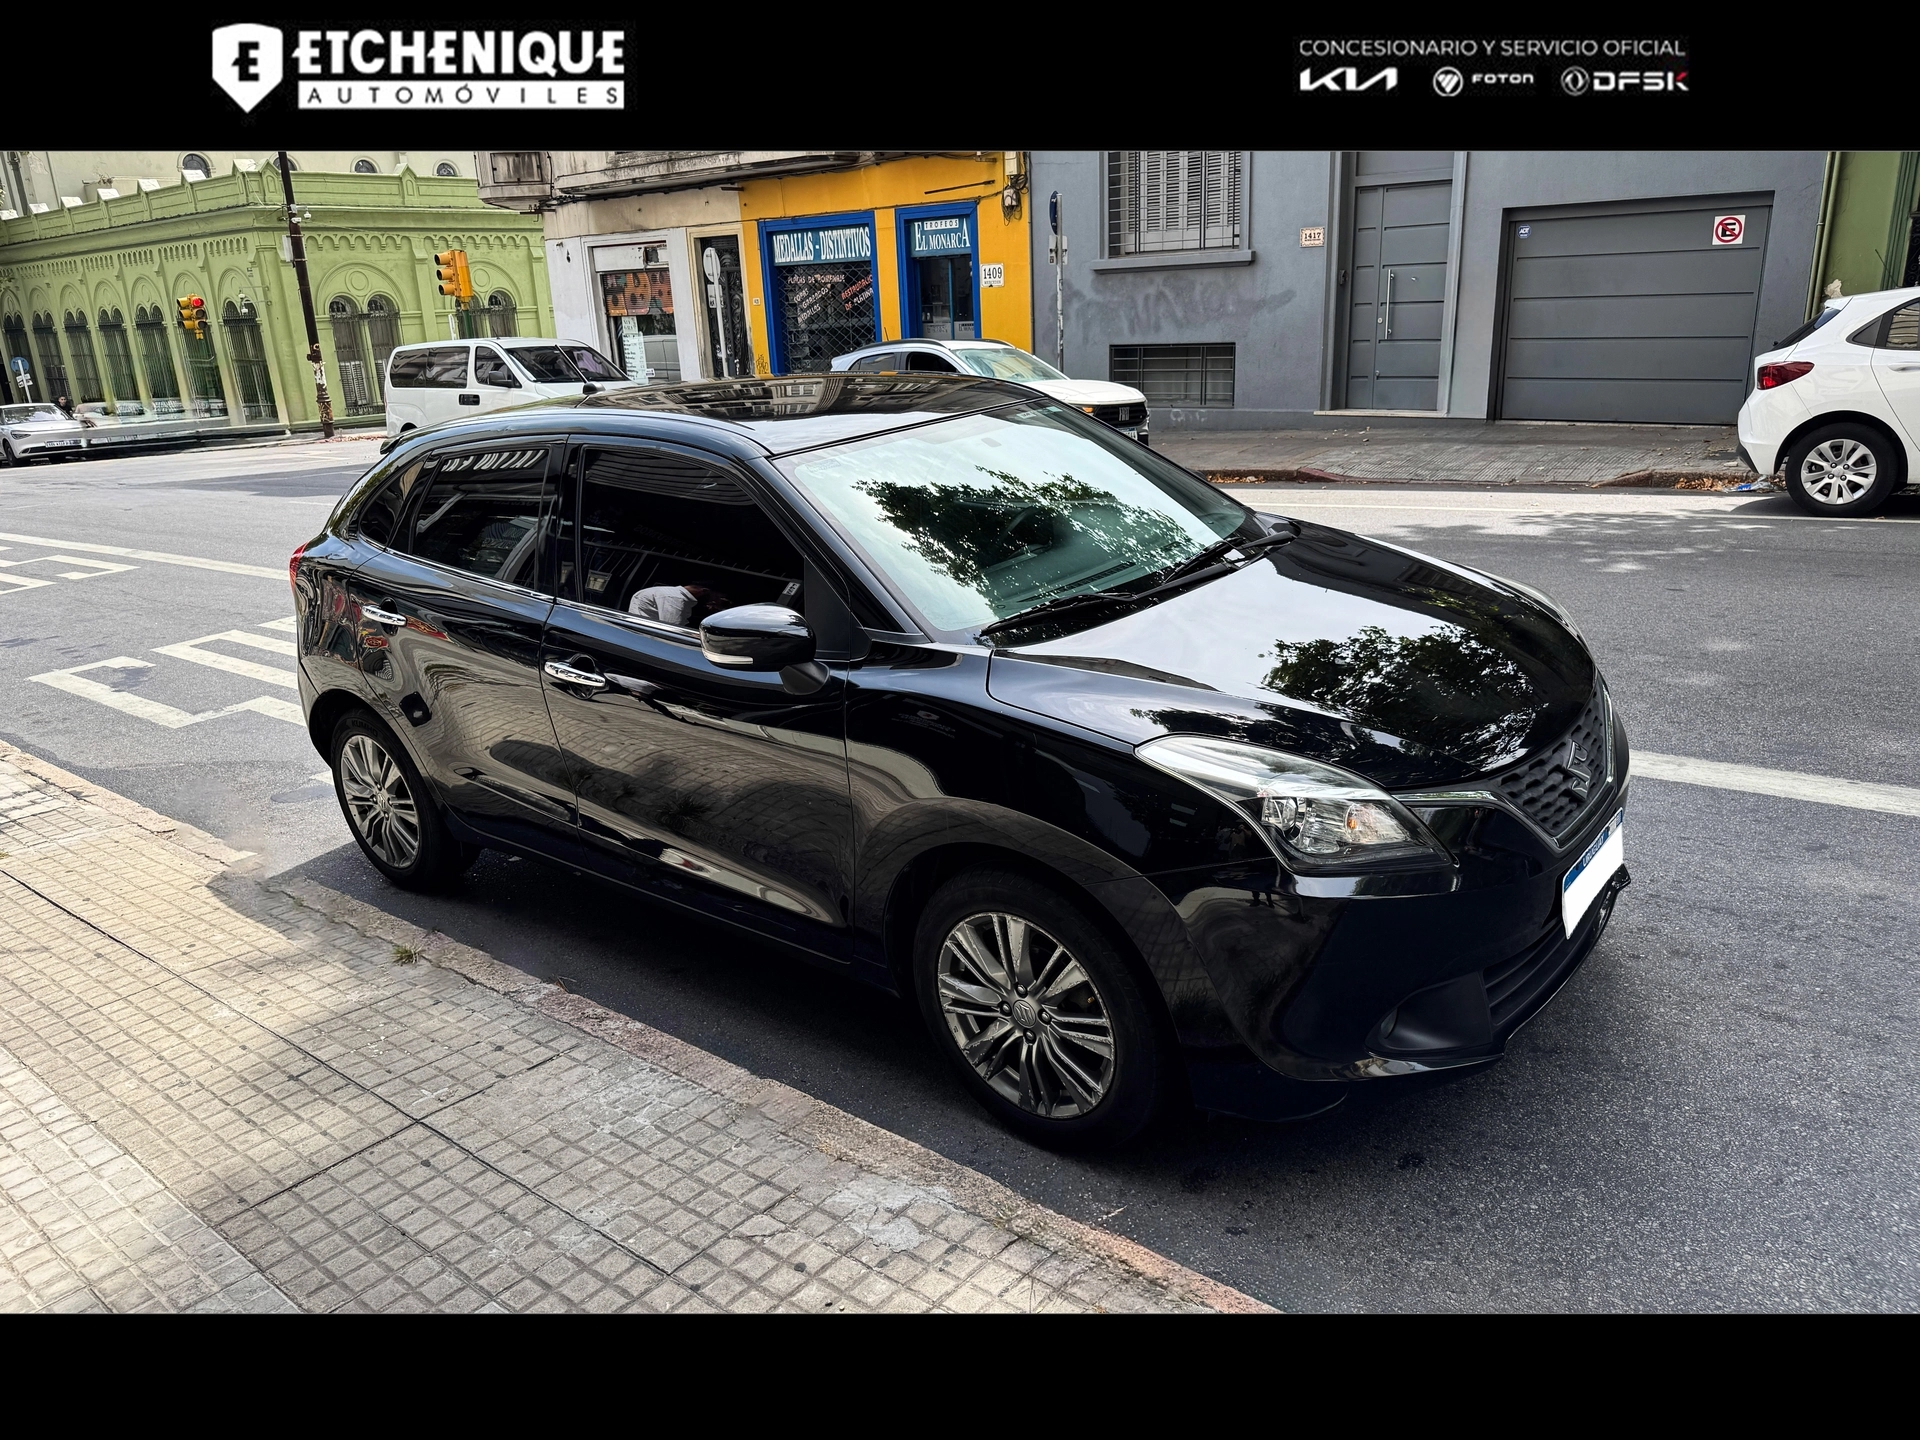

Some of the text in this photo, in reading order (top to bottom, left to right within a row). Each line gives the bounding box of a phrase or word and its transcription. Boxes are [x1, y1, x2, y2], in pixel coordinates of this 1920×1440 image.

[925, 219, 958, 229] TROFEOS
[929, 218, 971, 250] MONARCA
[773, 231, 814, 263] MEDALLAS
[819, 226, 871, 260] DISTINTIVOS
[983, 266, 1003, 280] 1409
